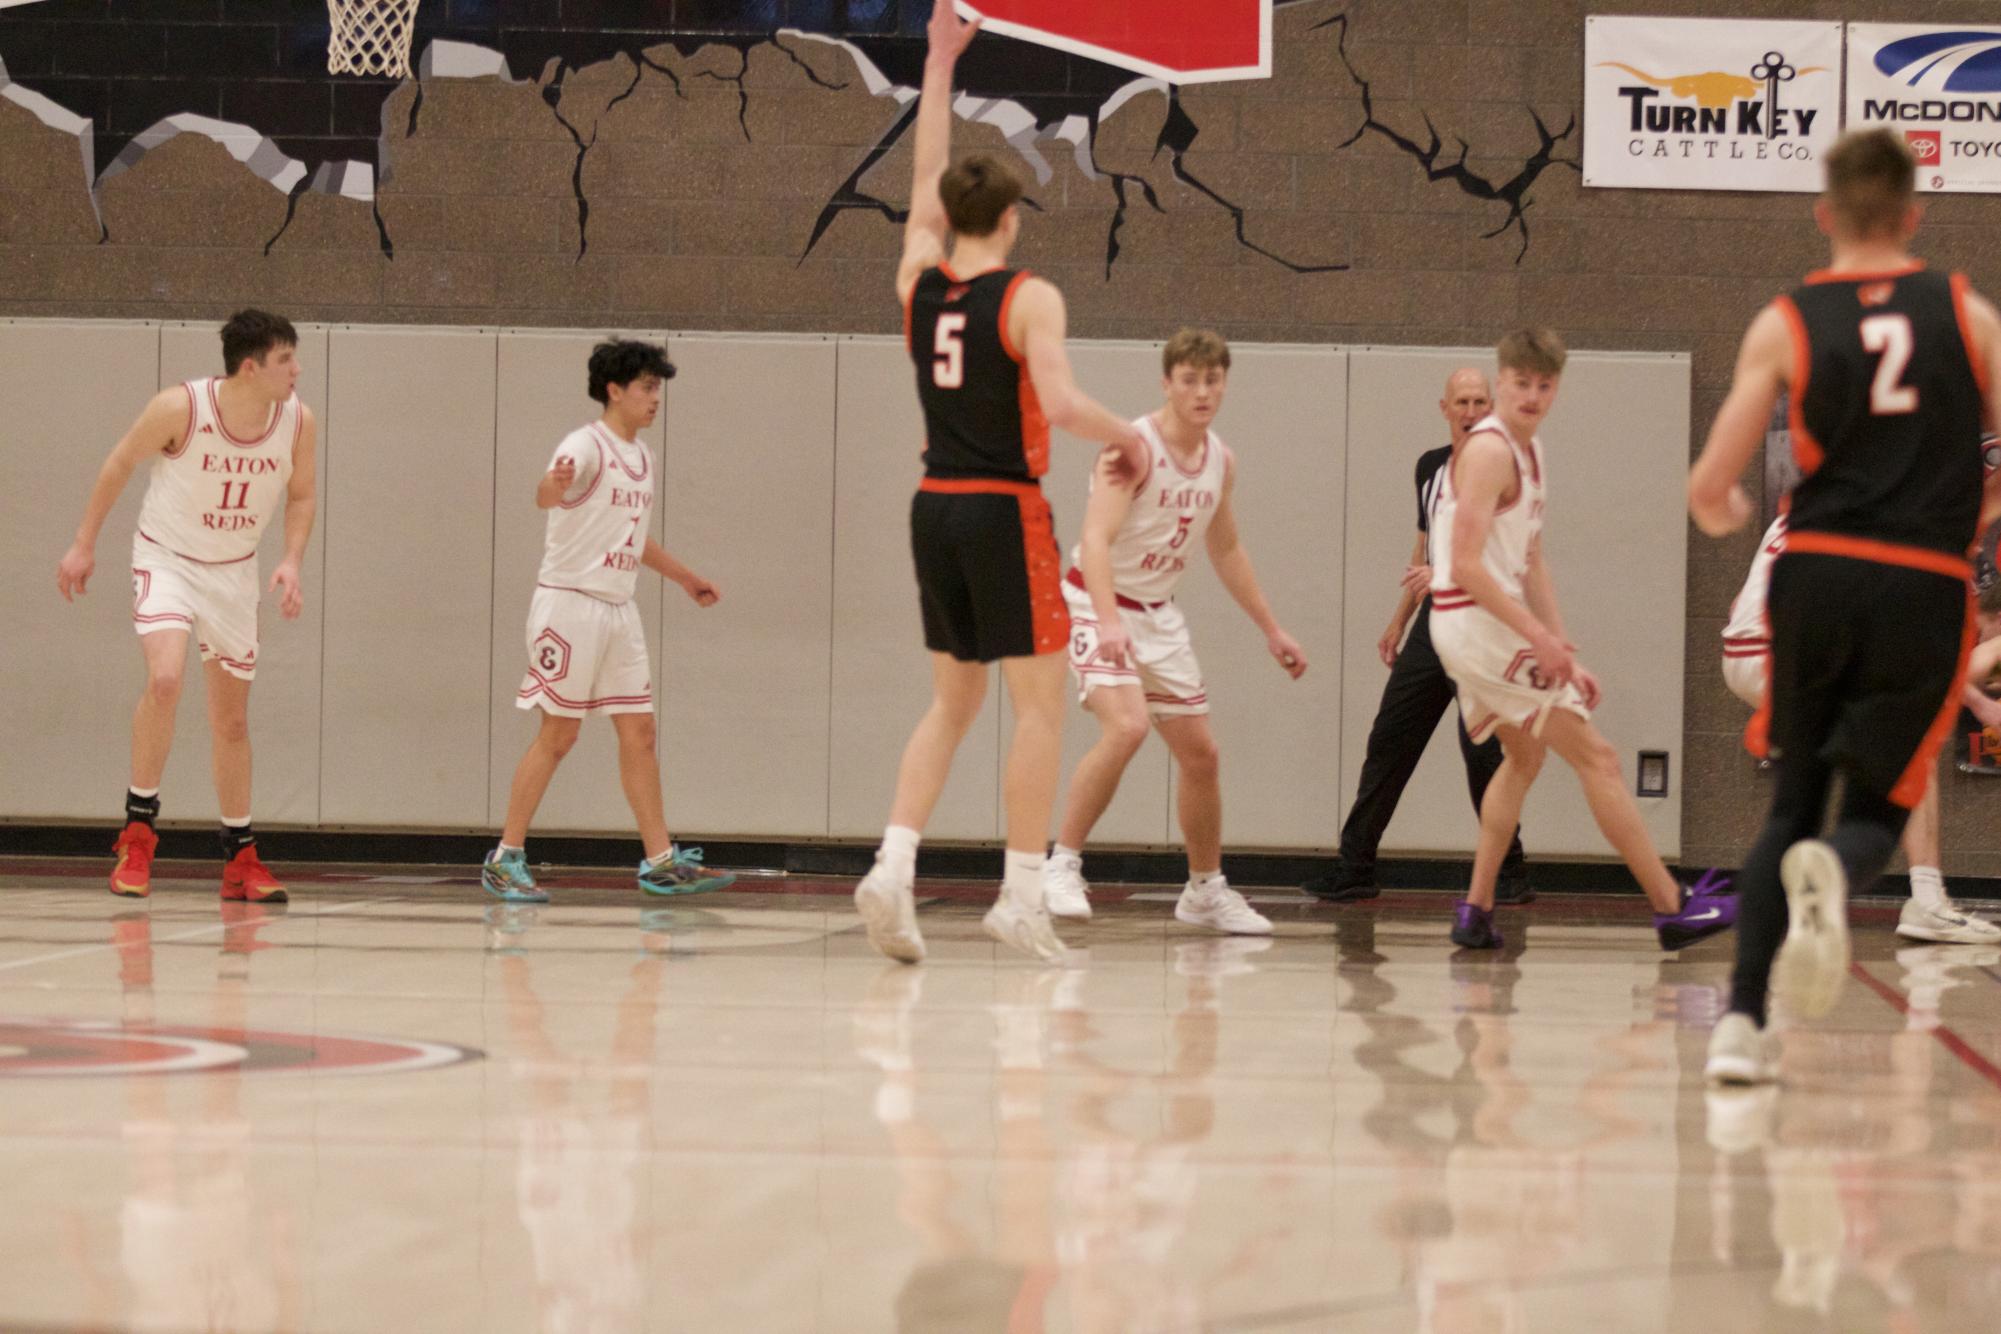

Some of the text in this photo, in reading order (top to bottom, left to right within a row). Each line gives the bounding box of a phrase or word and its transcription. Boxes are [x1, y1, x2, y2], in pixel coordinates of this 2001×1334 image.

[1628, 139, 1768, 160] CATTLE
[933, 311, 967, 389] 5
[1859, 312, 1920, 415] 2
[202, 453, 281, 475] EATON
[216, 480, 250, 510] 11
[202, 513, 259, 531] REDS
[1168, 516, 1194, 550] 5
